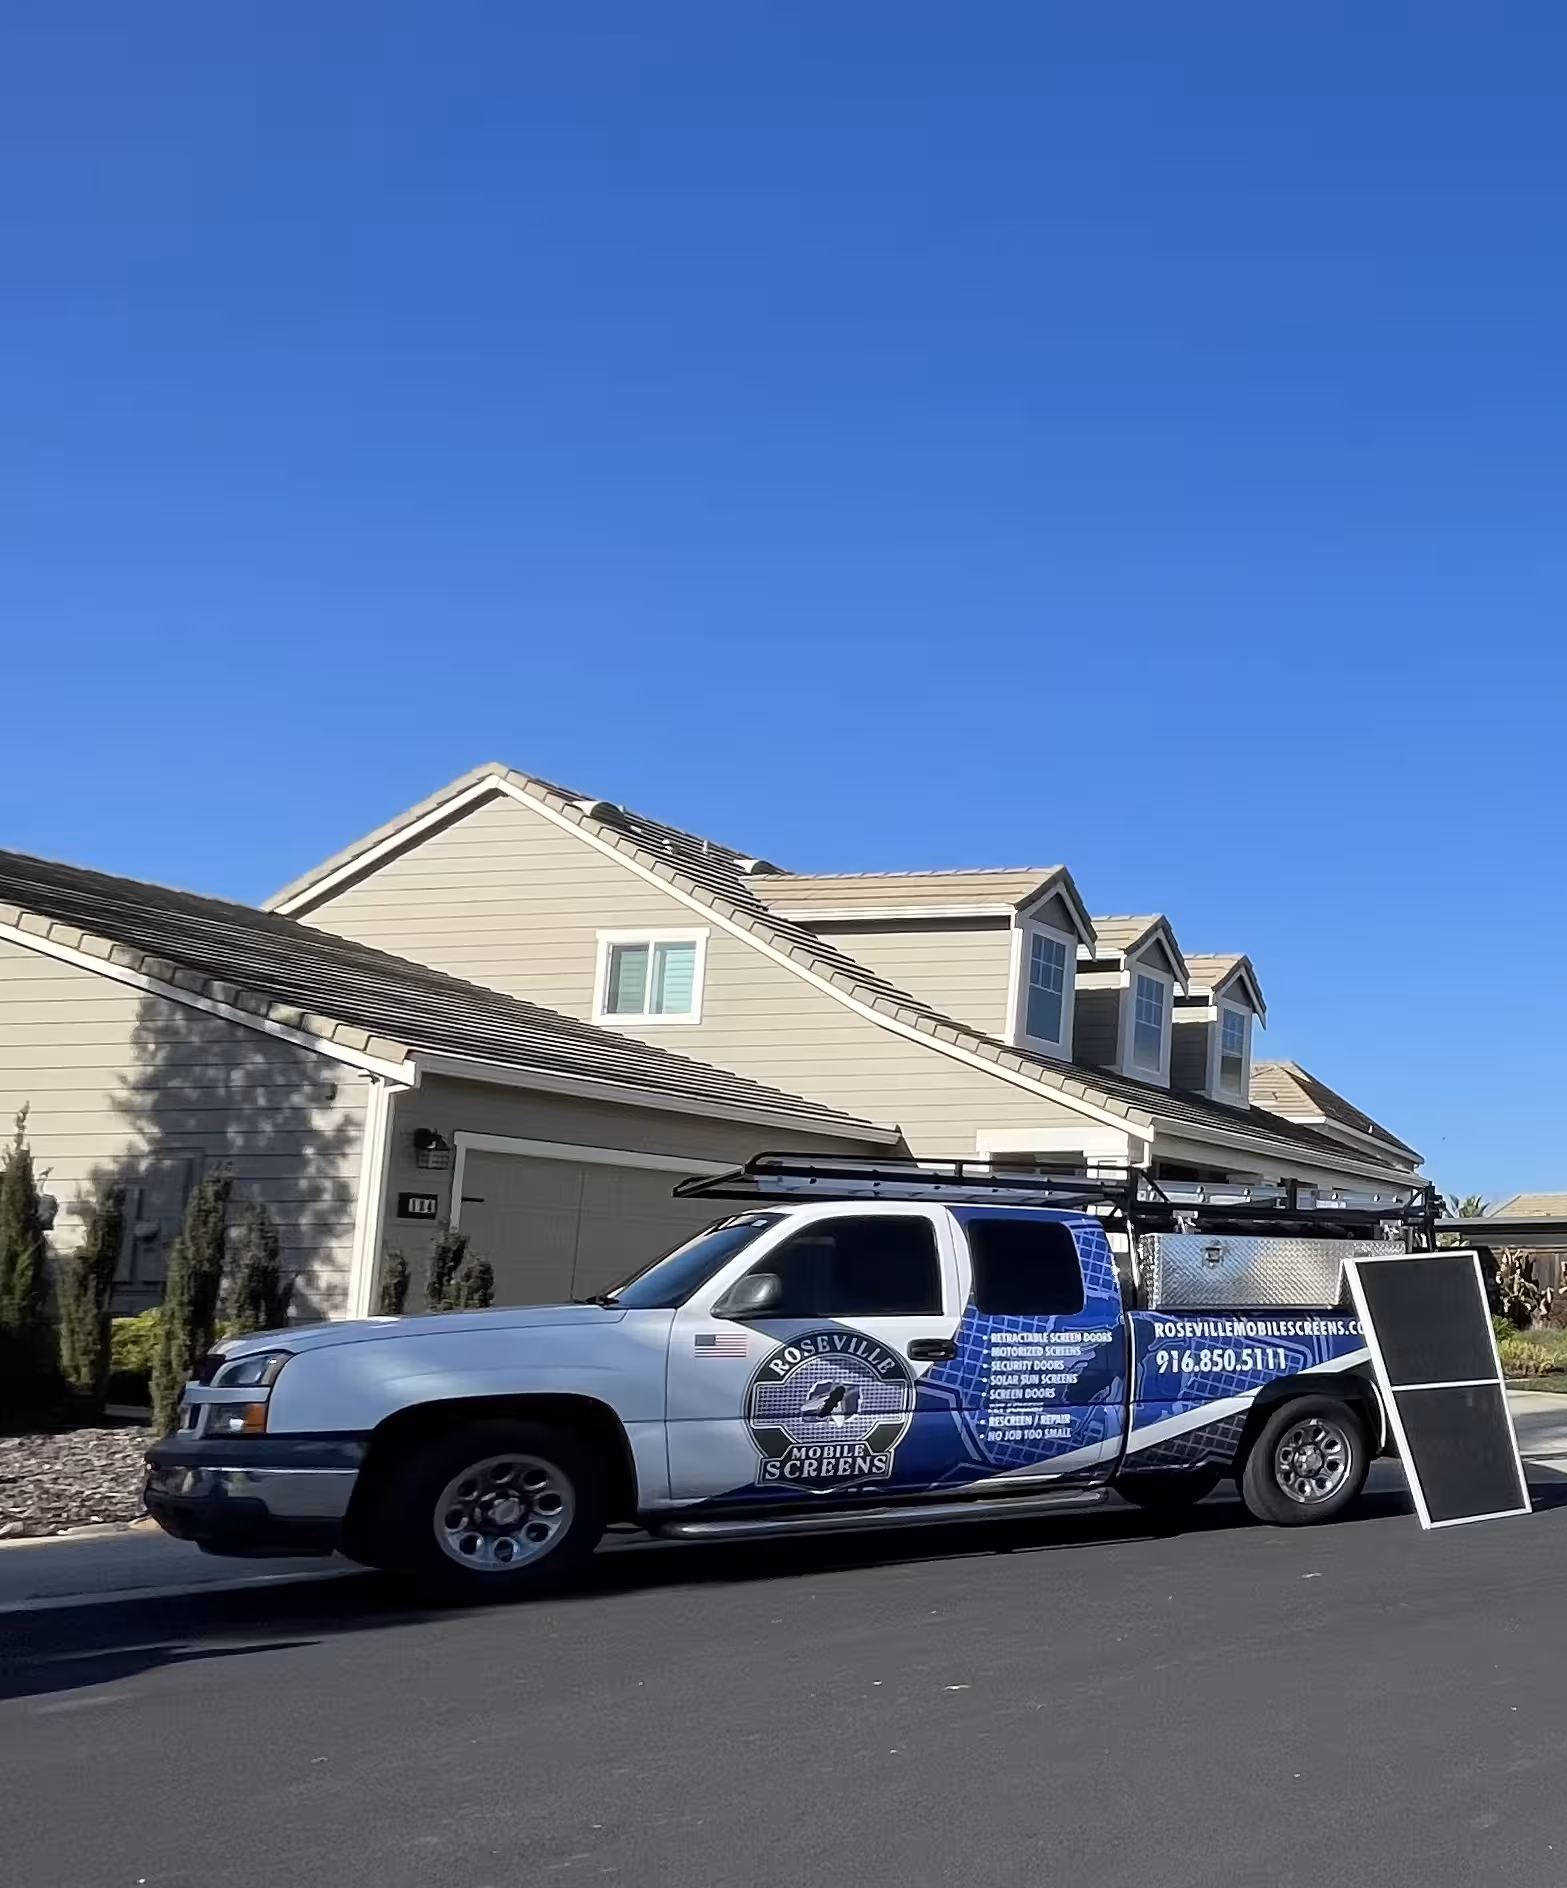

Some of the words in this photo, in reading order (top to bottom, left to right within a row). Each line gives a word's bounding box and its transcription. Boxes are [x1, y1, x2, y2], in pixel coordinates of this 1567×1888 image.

[991, 1333, 1048, 1343] RETRACTABLE
[1050, 1332, 1081, 1343] SCREEN
[1083, 1332, 1112, 1342] DOORS
[768, 1335, 896, 1377] ROSEVILLE
[991, 1346, 1043, 1357] MOTORIZED
[1045, 1345, 1081, 1356] SCREENS
[991, 1360, 1032, 1371] SECURITY
[1034, 1359, 1065, 1371] DOORS
[1156, 1348, 1286, 1374] 916.850.5111
[990, 1375, 1018, 1386] SOLAR
[1020, 1374, 1039, 1385] SUN
[1041, 1373, 1078, 1384] SCREENS
[990, 1389, 1023, 1400] SCREEN
[1025, 1388, 1055, 1399] DOORS
[988, 1416, 1032, 1427] RESCREEN
[1040, 1414, 1071, 1425] REPAIR
[988, 1431, 1002, 1441] NO
[1004, 1430, 1021, 1441] JOB
[1024, 1429, 1042, 1440] TOO
[1044, 1428, 1071, 1439] SMALL
[791, 1444, 865, 1460] MOBILE
[765, 1455, 887, 1480] SCREENS
